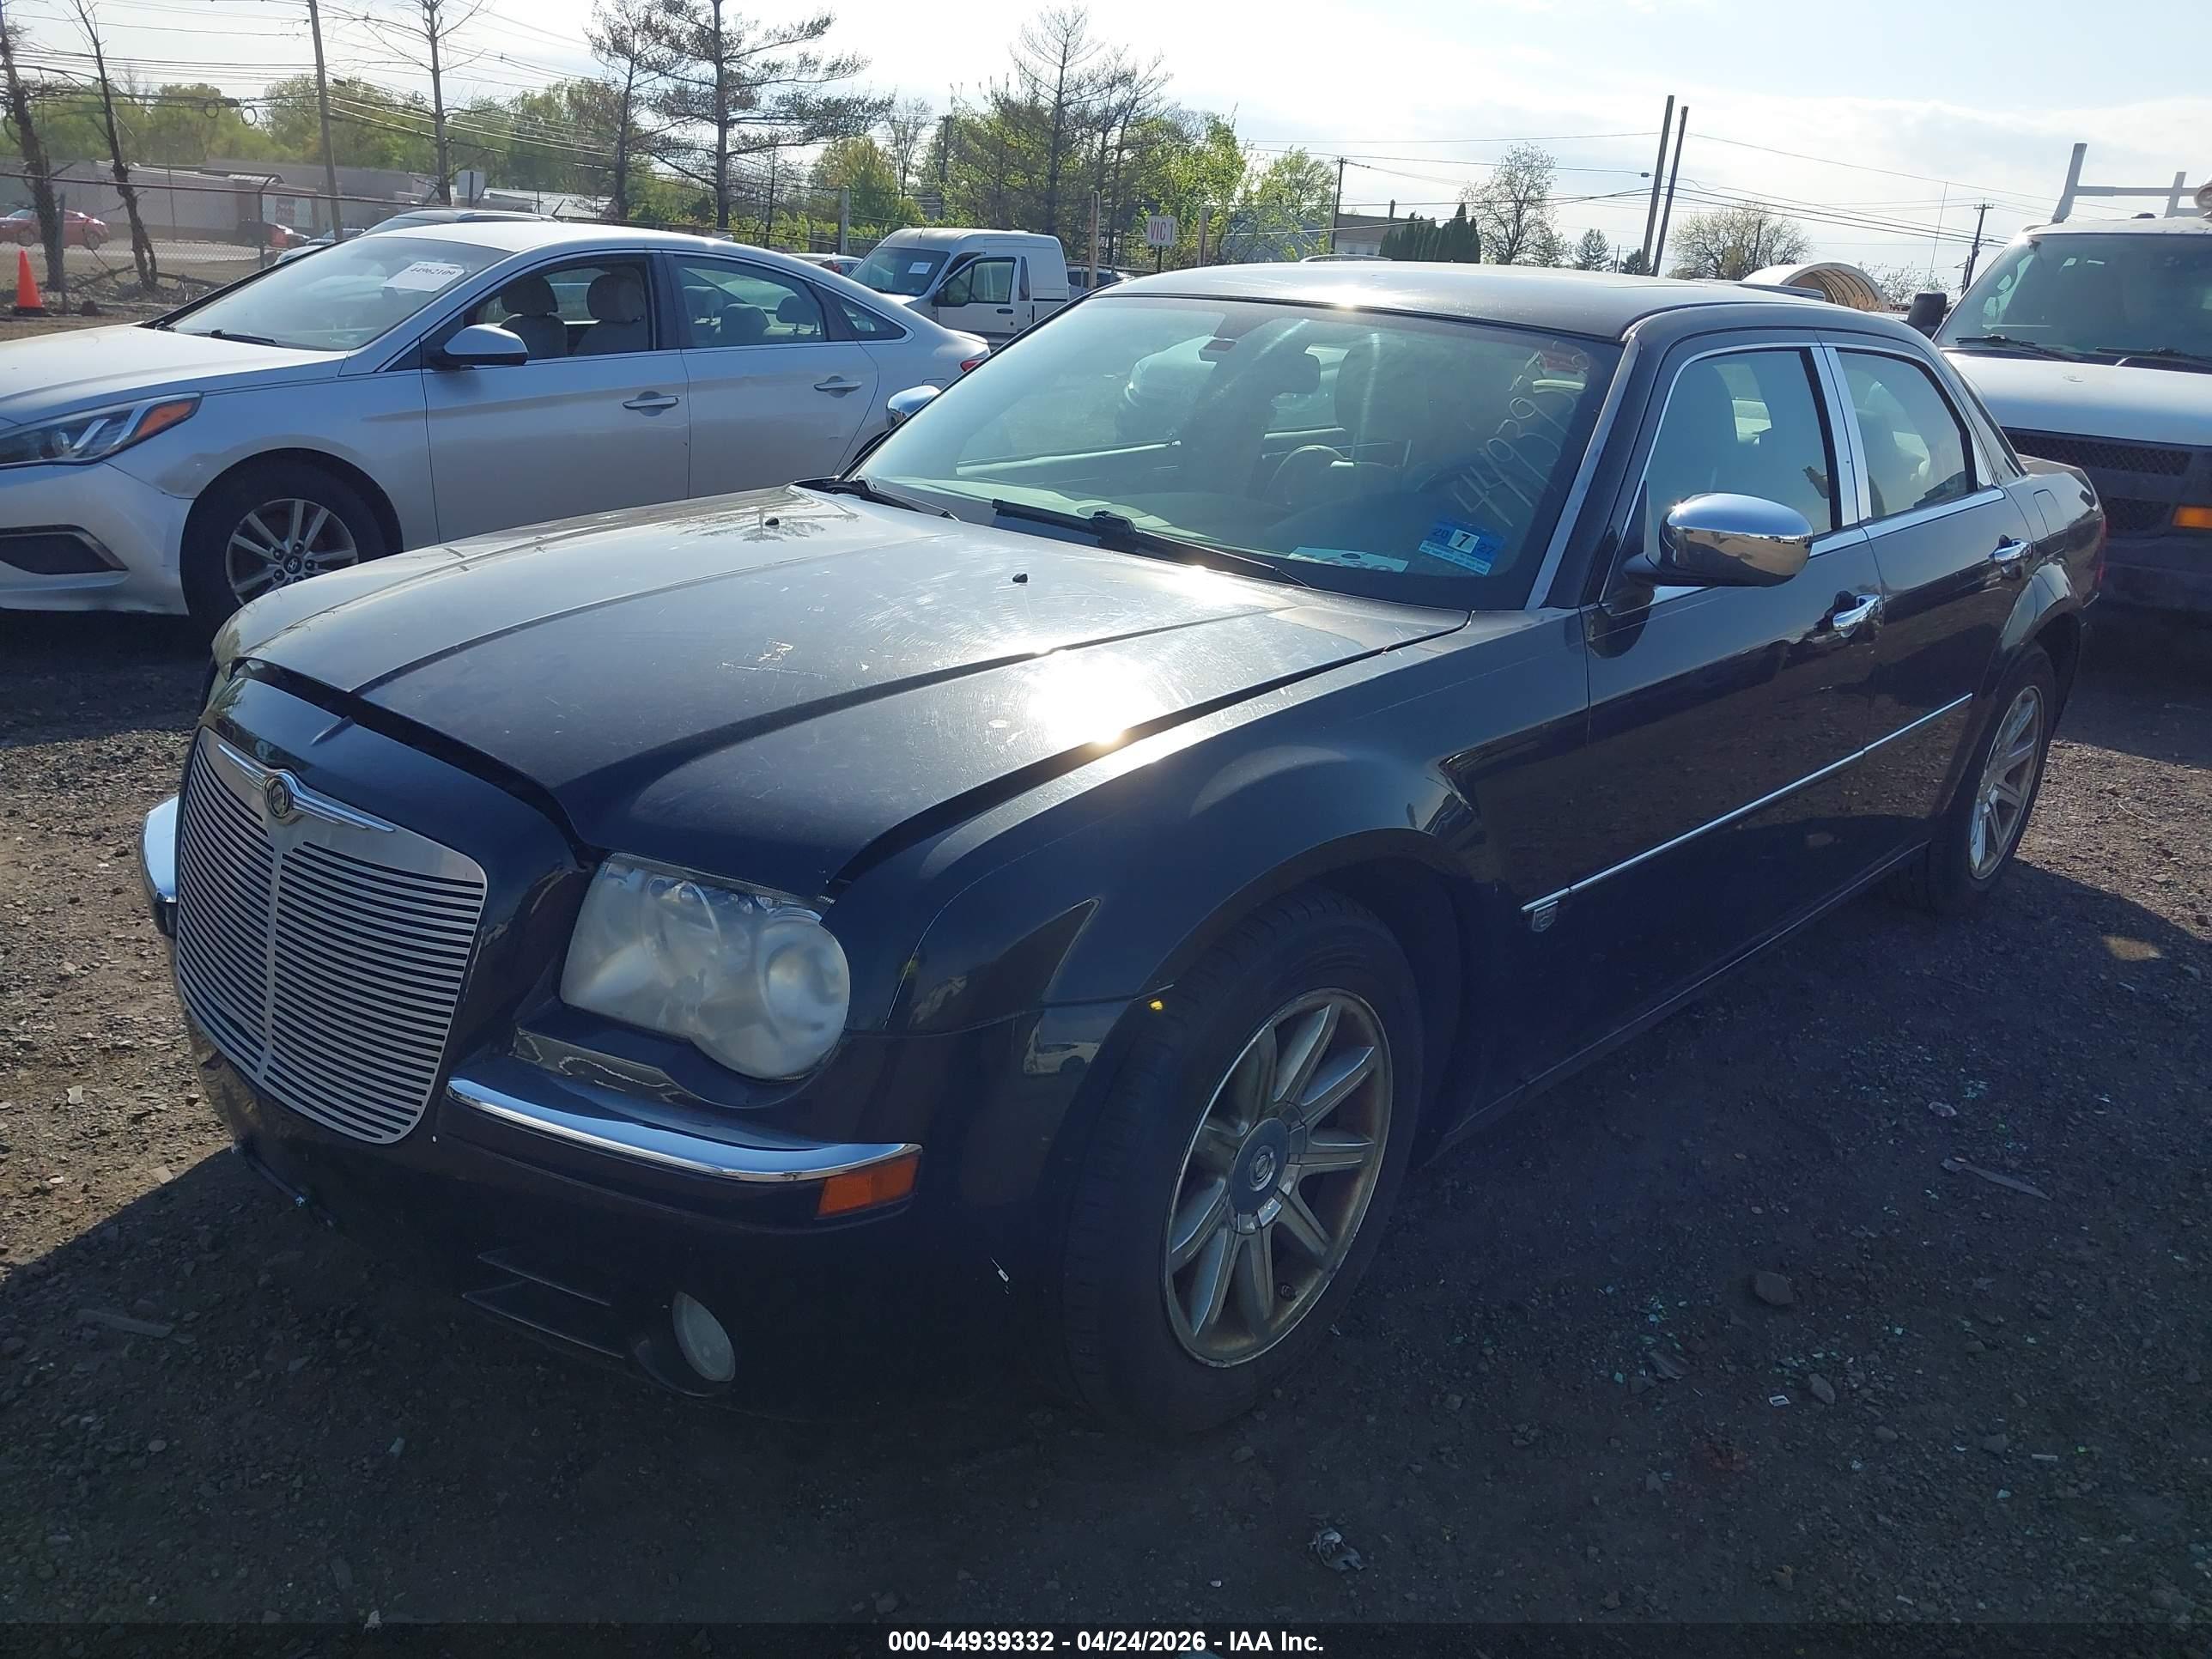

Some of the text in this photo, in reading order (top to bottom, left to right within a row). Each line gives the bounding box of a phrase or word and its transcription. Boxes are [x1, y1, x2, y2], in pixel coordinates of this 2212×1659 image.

[1151, 221, 1173, 241] VIC 1
[1456, 532, 1471, 548] 7
